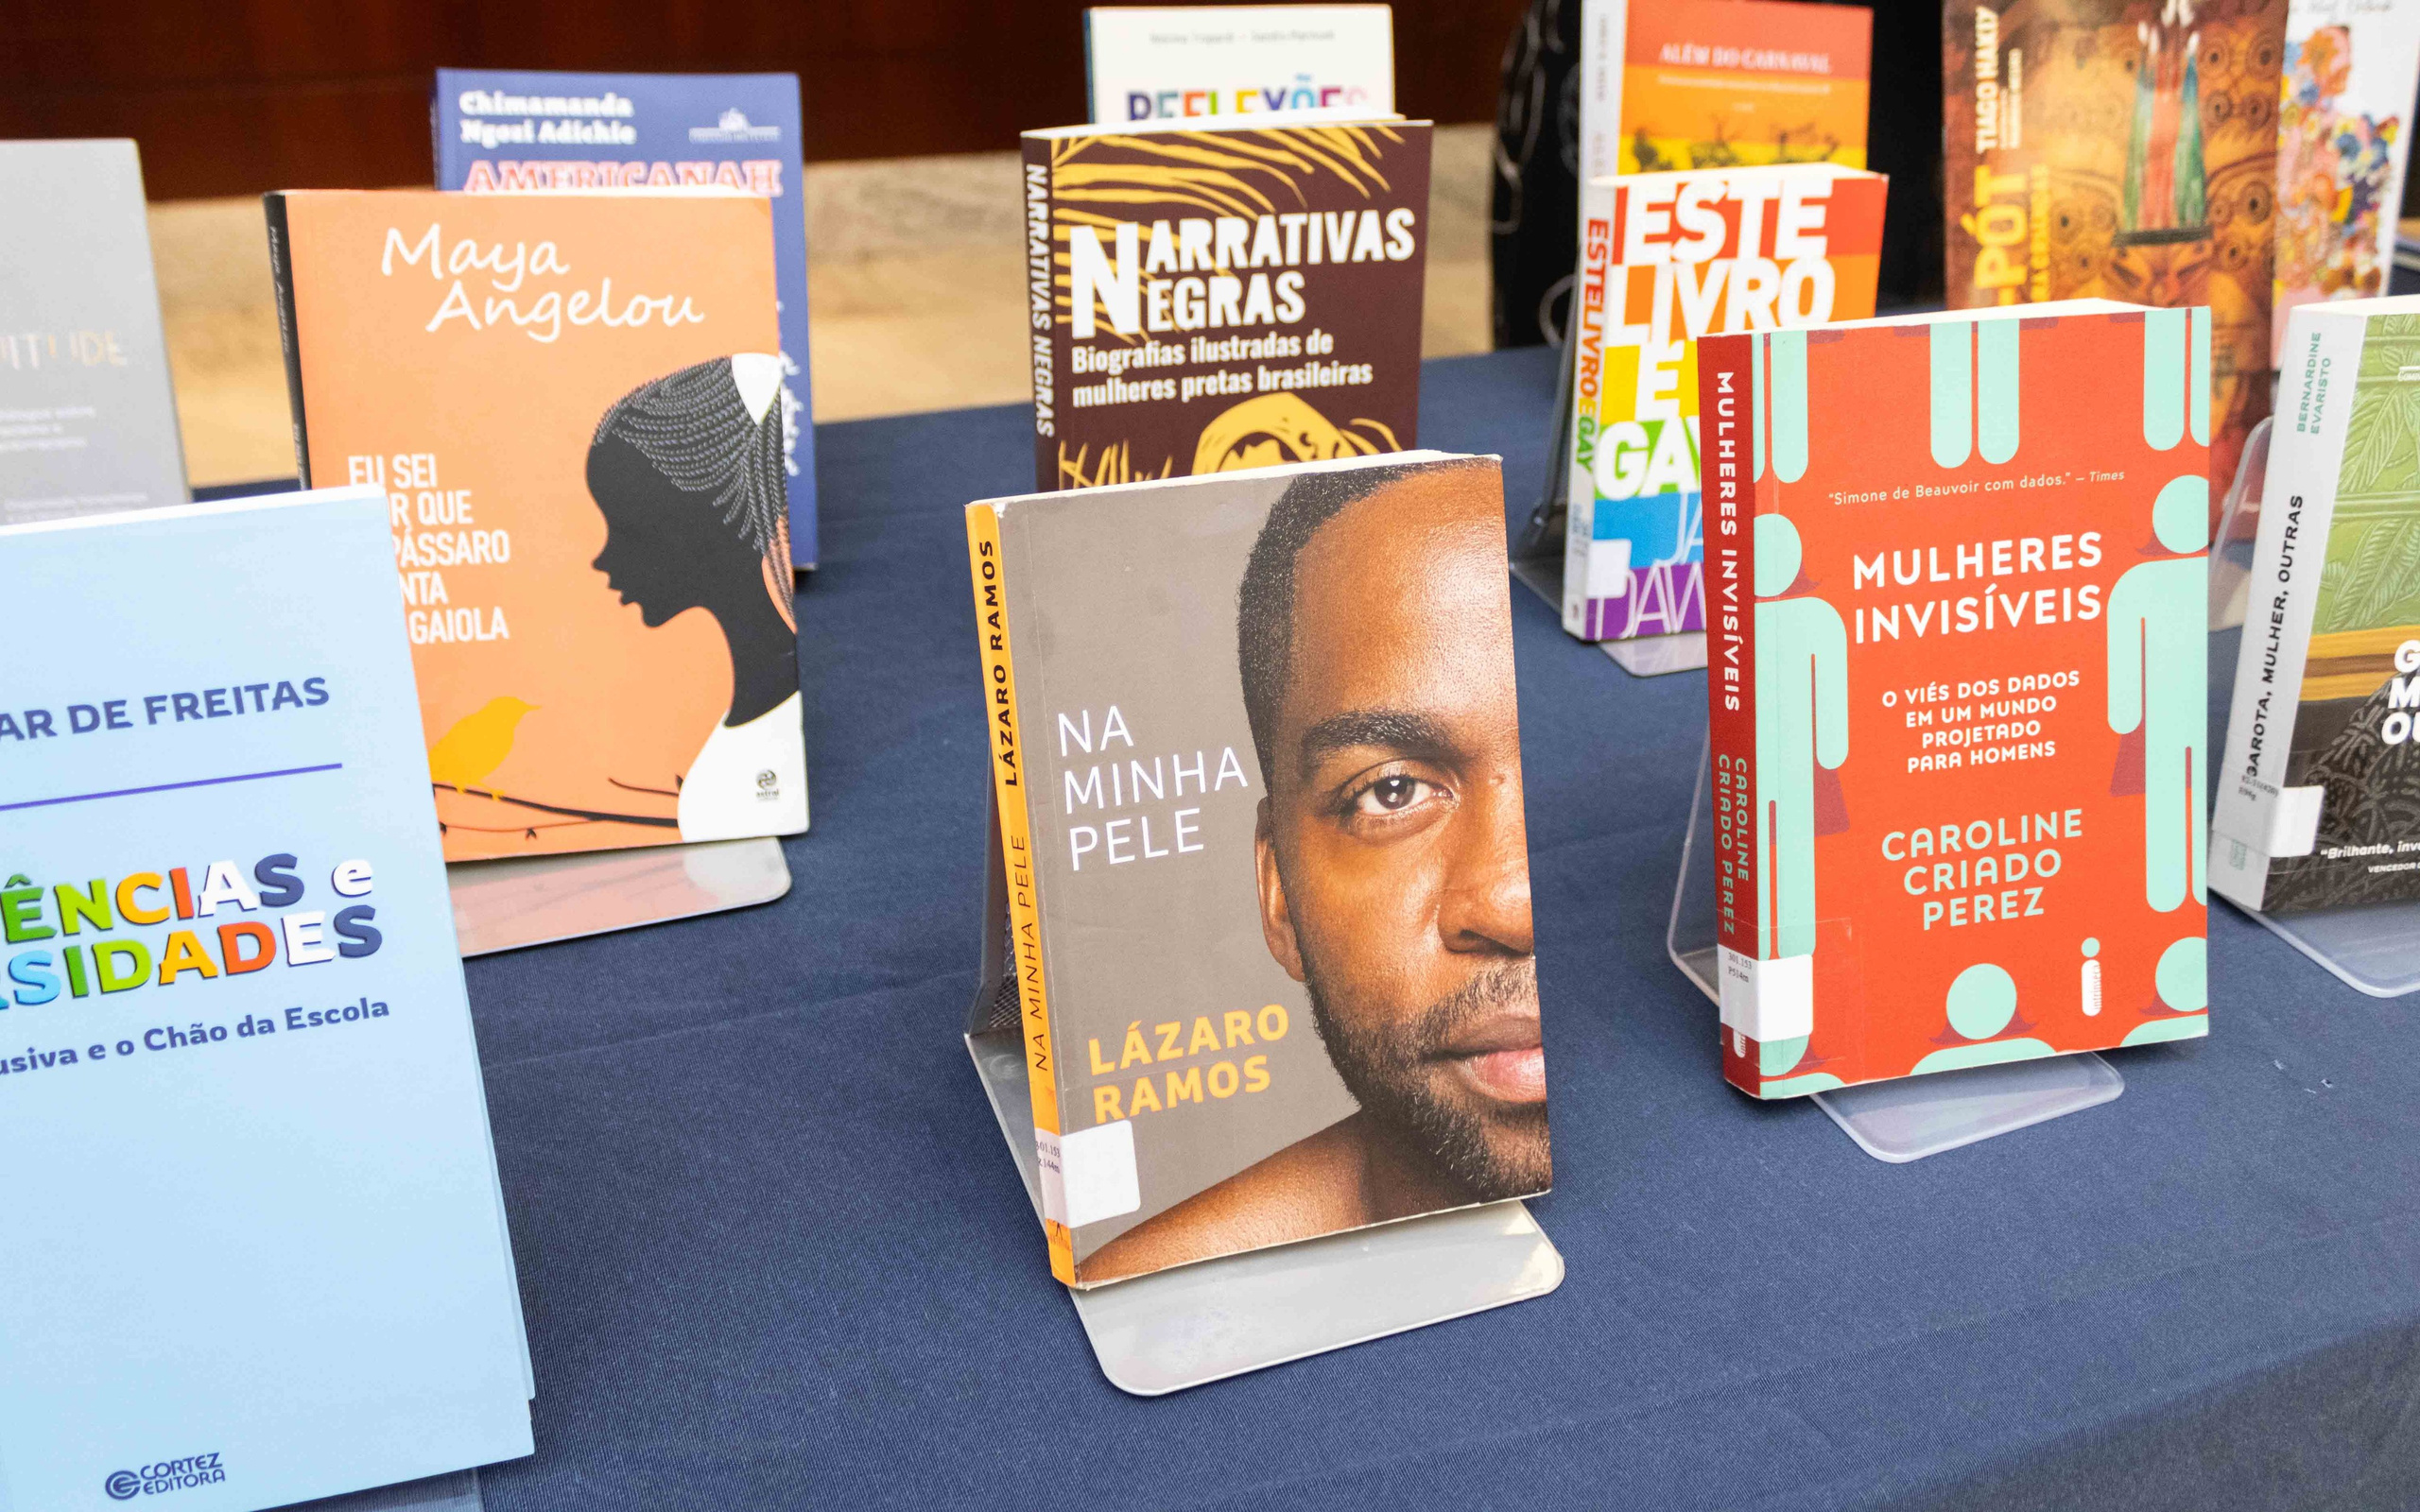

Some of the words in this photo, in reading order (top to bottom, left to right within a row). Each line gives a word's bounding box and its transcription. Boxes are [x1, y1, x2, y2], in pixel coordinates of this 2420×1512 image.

[459, 90, 634, 117] Chimamanda
[538, 119, 637, 145] Adichie
[463, 160, 784, 197] AMERICANAH
[1025, 163, 1051, 331] NARRATIVAS
[1623, 176, 1834, 266] ESTE
[381, 223, 570, 291] Maya
[1069, 208, 1416, 338] NARRATIVAS
[424, 277, 705, 344] Angelou
[1605, 257, 1836, 348] LIVRO
[1071, 338, 1186, 374] Biografias
[1190, 331, 1302, 365] ilustradas
[1306, 328, 1334, 354] de
[2296, 332, 2322, 433] BERNARDINE
[1031, 335, 1055, 438] NEGRAS
[1072, 377, 1177, 408] mulheres
[1181, 371, 1253, 403] pretas
[1257, 362, 1374, 393] brasileiras
[2309, 356, 2331, 435] EVARISTO
[348, 455, 386, 487] EU
[392, 454, 438, 490] SEI
[1716, 371, 1737, 537] MULHERES
[1892, 486, 1910, 501] de
[1915, 479, 1979, 499] Beauvoir
[1984, 477, 2014, 492] com
[2088, 469, 2125, 483] Times
[417, 490, 474, 525] QUE
[1853, 531, 2102, 590] MULHERES
[2261, 590, 2289, 684] MULHER,
[2277, 495, 2303, 583] OUTRAS
[408, 606, 510, 644] GAIOLA
[979, 541, 1004, 651] RAMOS
[1855, 583, 2101, 644] INVISÍVEIS
[1721, 548, 1745, 713] INVISÍVEIS
[0, 709, 58, 741] AR
[67, 699, 133, 734] DE
[144, 677, 330, 726] FREITAS
[1882, 691, 1897, 708] O
[1904, 681, 1950, 706] VIÉS
[1958, 678, 2001, 701] DOS
[2007, 670, 2081, 696] DADOS
[1905, 710, 1933, 729] EM
[1941, 705, 1972, 725] UM
[1979, 695, 2057, 720] MUNDO
[993, 664, 1018, 787] LÁZARO
[1057, 705, 1133, 757] NA
[1907, 752, 1962, 774] PARA
[1970, 740, 2056, 765] HOMENS
[1921, 719, 2041, 749] PROJETADO
[1063, 747, 1249, 815] MINHA
[1718, 754, 1733, 858] CRIADO
[1069, 807, 1204, 871] PELE
[1734, 757, 1750, 883] CAROLINE
[1881, 808, 2083, 862] CAROLINE
[0, 853, 305, 943] ÊNCIAS
[332, 859, 373, 898] e
[1011, 834, 1031, 908] PELE
[1721, 861, 1736, 936] PEREZ
[1903, 848, 2062, 898] CRIADO
[2368, 862, 2416, 873] VENCEDOR
[1923, 886, 2045, 931] PEREZ
[0, 904, 383, 1010] SIDADES
[1020, 922, 1043, 1021] MINHA
[88, 1043, 107, 1060] e
[115, 1040, 135, 1057] o
[144, 1022, 227, 1052] Chão
[236, 1014, 275, 1039] da
[285, 997, 389, 1032] Escola
[1033, 1032, 1048, 1072] NA
[1088, 1003, 1289, 1076] LÁZARO
[1093, 1055, 1271, 1125] RAMOS
[140, 1452, 223, 1480] CORTEZ
[143, 1469, 226, 1495] EDITORA
